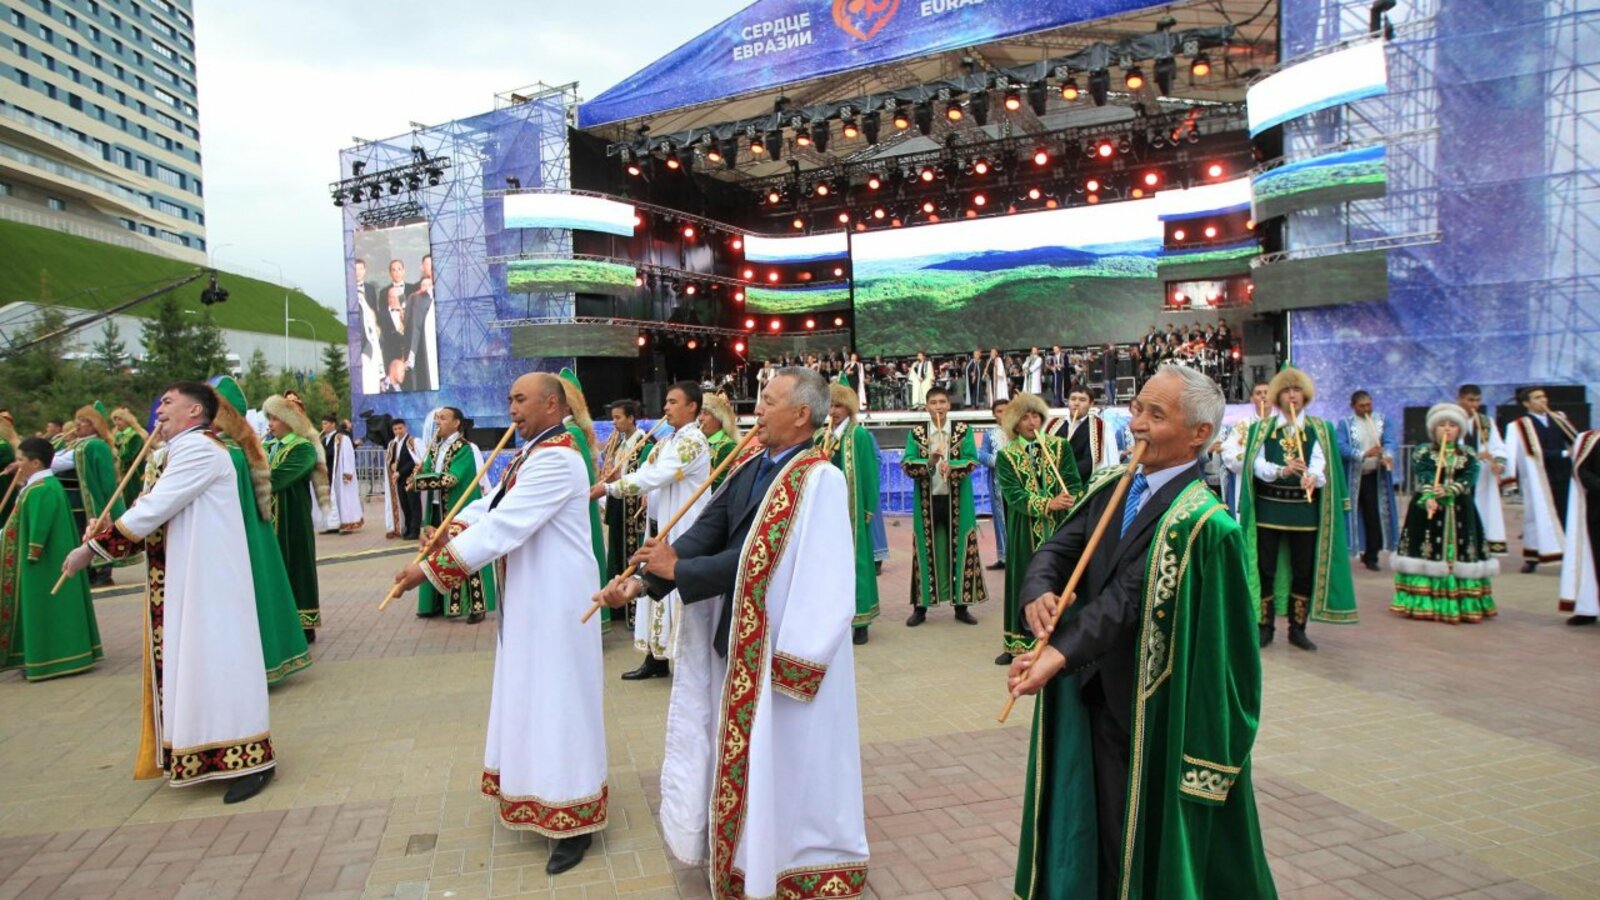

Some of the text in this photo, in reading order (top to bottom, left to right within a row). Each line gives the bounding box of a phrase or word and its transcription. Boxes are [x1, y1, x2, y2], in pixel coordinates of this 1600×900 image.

[920, 0, 983, 17] EUR
[741, 12, 811, 41] СЕРДЦЕ
[733, 30, 812, 61] ЕВРАЗИИ
